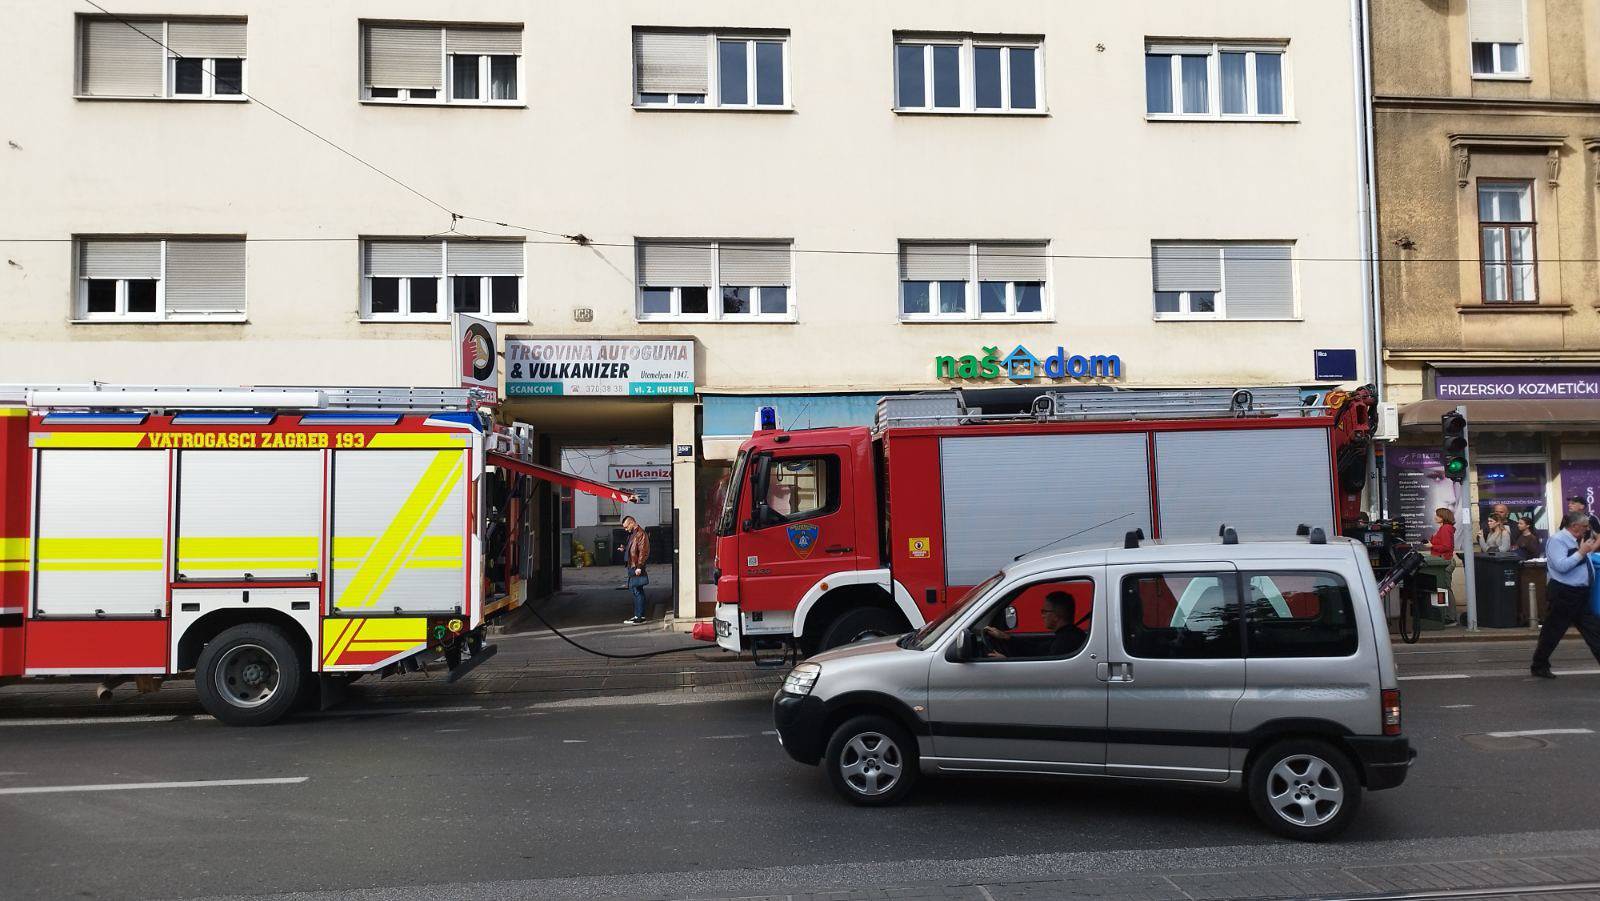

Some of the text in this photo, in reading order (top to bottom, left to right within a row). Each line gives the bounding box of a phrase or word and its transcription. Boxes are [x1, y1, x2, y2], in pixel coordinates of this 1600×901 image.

[510, 344, 688, 361] TRGOVINA AUTOGUMA
[936, 345, 1121, 379] naš dom
[510, 363, 630, 379] & VULKANIZER
[510, 386, 553, 394] SCANCOM
[657, 386, 689, 394] KUFNER
[1439, 380, 1599, 396] FRIZERSKO KOZMETIČKI
[148, 432, 365, 448] VATROGASCI ZAGREB 193
